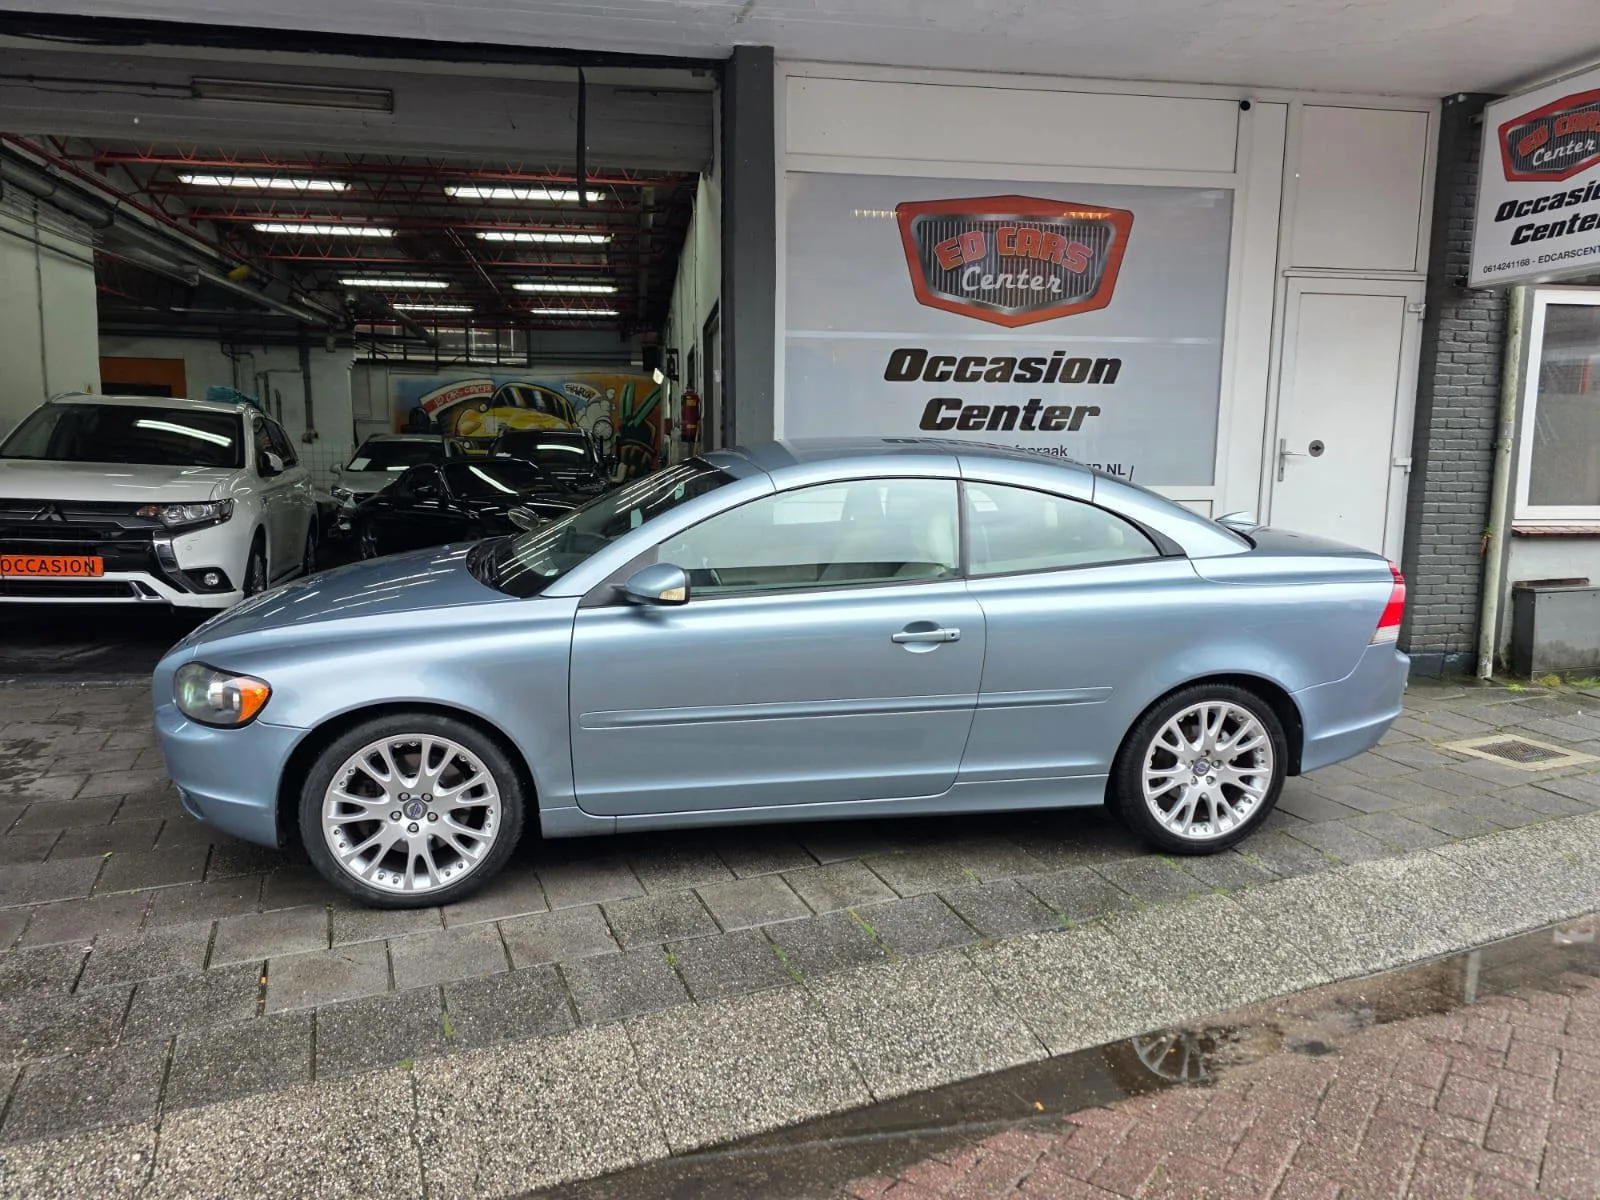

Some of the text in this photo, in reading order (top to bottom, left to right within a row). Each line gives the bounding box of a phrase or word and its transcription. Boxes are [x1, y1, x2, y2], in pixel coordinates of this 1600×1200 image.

[1554, 111, 1600, 137] CAR
[1532, 138, 1596, 166] Center
[1510, 213, 1600, 246] Cente
[934, 227, 1093, 273] ED CARS
[962, 266, 1062, 293] Center
[883, 348, 1122, 384] Occasion
[919, 397, 1100, 432] Center
[0, 558, 95, 573] OCCASION
